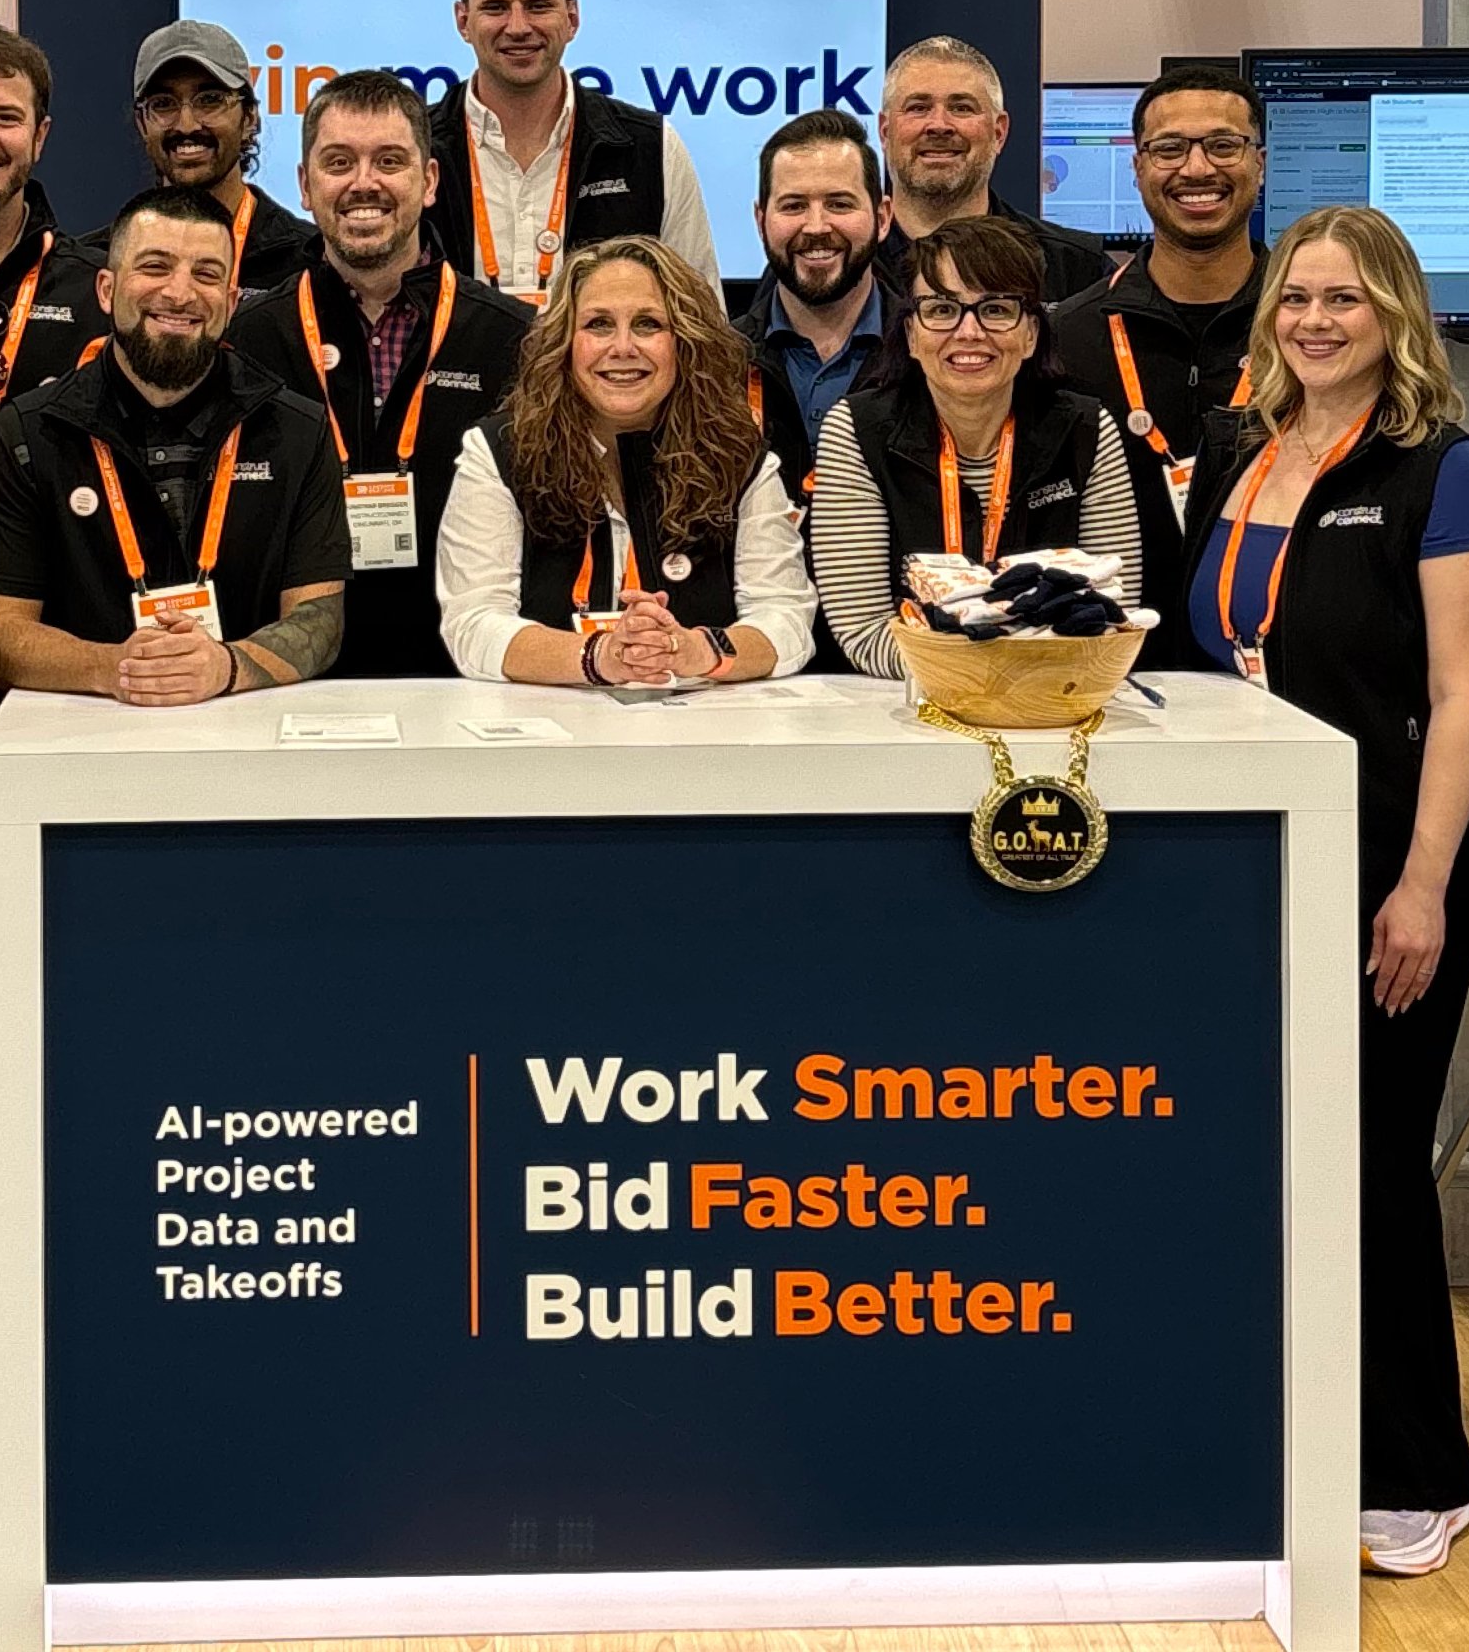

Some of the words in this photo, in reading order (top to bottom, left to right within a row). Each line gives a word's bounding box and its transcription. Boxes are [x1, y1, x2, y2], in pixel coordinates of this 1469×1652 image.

[645, 48, 874, 115] work
[526, 1052, 769, 1124] Work
[793, 1054, 1174, 1121] Smarter.
[155, 1100, 418, 1146] AI-powered
[157, 1156, 316, 1199] Project
[526, 1161, 669, 1231] Bid
[690, 1163, 987, 1229] Faster.
[157, 1212, 259, 1247] Data
[274, 1207, 356, 1245] and
[155, 1261, 343, 1300] Takeoffs
[526, 1268, 753, 1340] Build
[775, 1270, 1073, 1336] Better.
